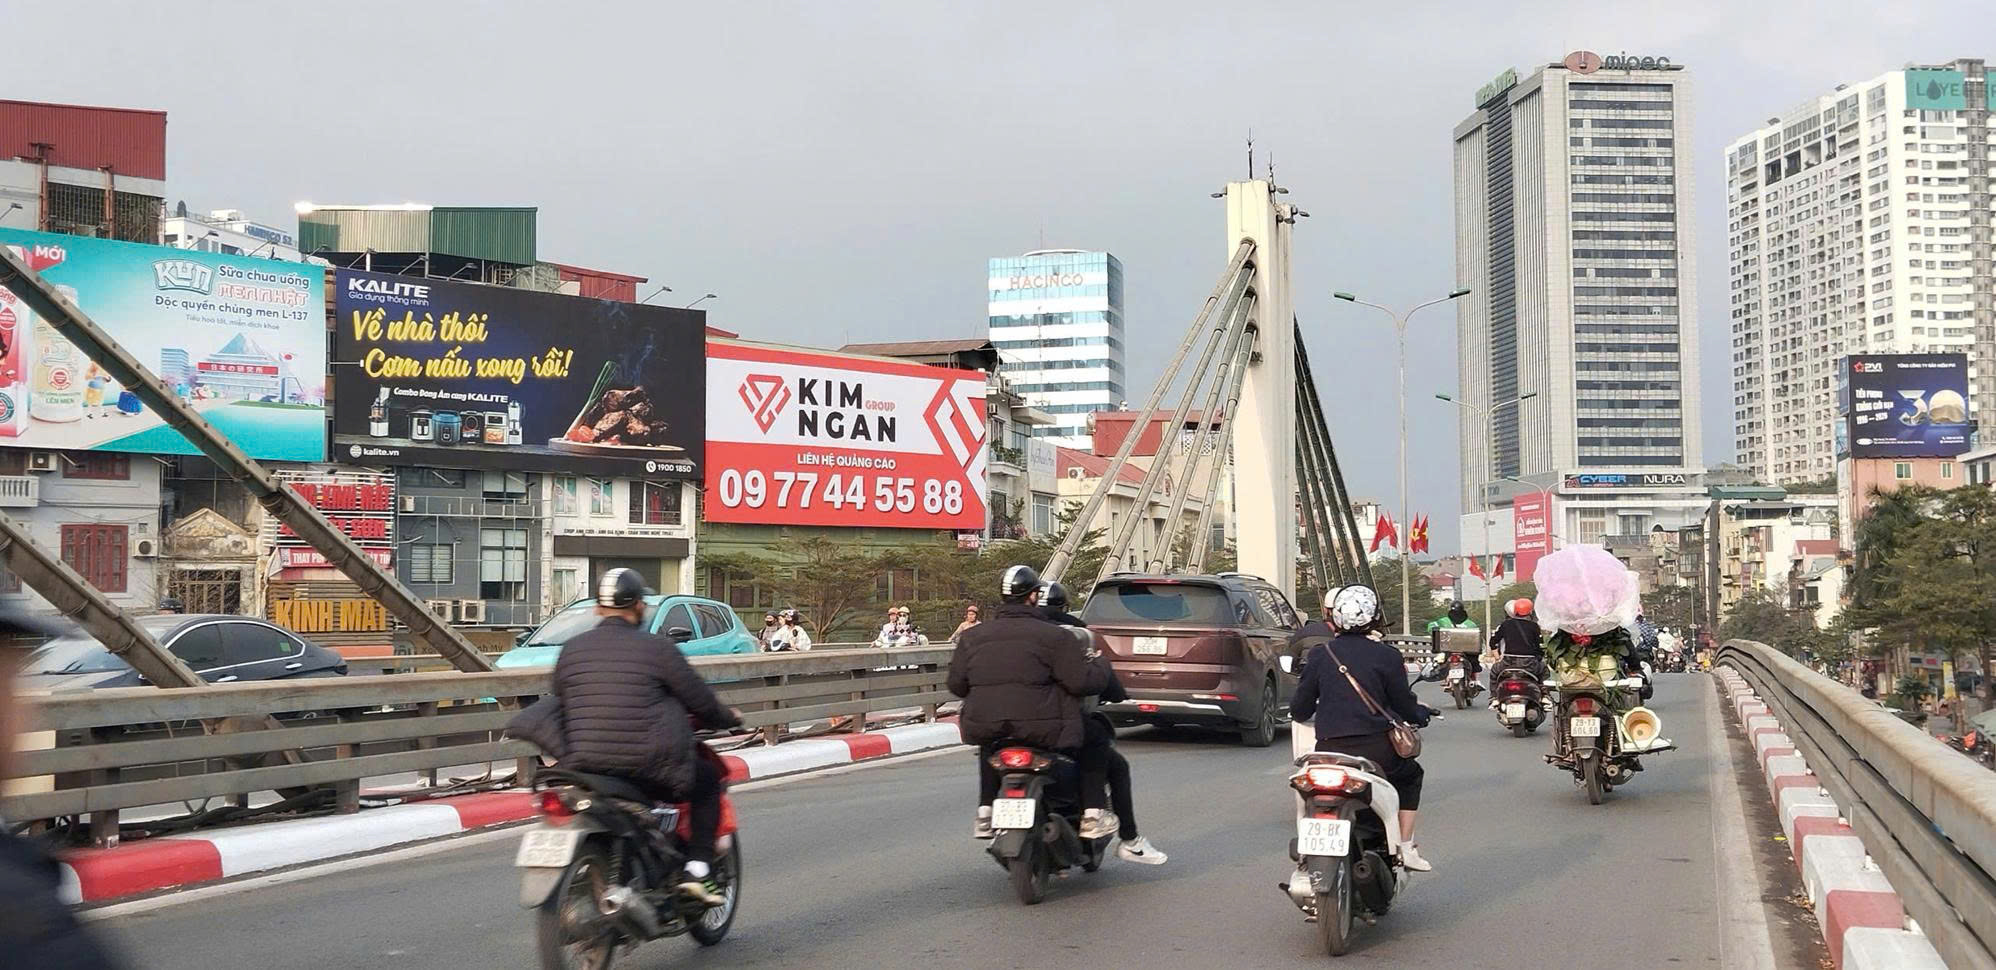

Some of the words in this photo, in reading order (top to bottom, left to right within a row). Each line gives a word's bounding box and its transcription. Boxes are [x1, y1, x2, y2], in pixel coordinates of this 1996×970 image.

[1604, 51, 1670, 72] mipec
[35, 244, 66, 262] MỚI
[219, 265, 243, 278] Sữa
[247, 269, 276, 283] chua
[280, 272, 309, 289] uống
[1010, 272, 1084, 290] HACINCO
[219, 283, 257, 301] MEN
[348, 278, 429, 298] KALITE
[155, 295, 177, 309] Độc
[181, 297, 216, 312] quyền
[218, 302, 253, 317] chủng
[256, 308, 279, 318] men
[282, 310, 308, 321] L-137
[348, 291, 363, 299] Gia
[364, 292, 386, 303] dụng
[386, 295, 410, 306] thông
[410, 298, 430, 307] minh
[352, 307, 386, 342] Về
[386, 310, 437, 342] nhà
[440, 311, 489, 342] thôi
[364, 347, 422, 378] Cơm
[425, 345, 473, 378] nấu
[476, 357, 526, 385] xong
[530, 346, 574, 378] rồi!
[393, 387, 419, 397] Combo
[468, 393, 508, 404] KALITE
[799, 377, 863, 410] KIM
[865, 399, 896, 412] GROUP
[799, 409, 897, 443] NGAN
[363, 447, 400, 457] kalite.vn
[797, 452, 820, 466] LIÊN
[821, 452, 835, 468] HỆ
[836, 453, 873, 470] QUẢNG
[873, 456, 897, 470] CÁO
[657, 462, 675, 471] 1900
[676, 463, 692, 473] 1850
[1580, 475, 1627, 483] CYBER
[1643, 474, 1685, 484] NURA
[719, 469, 767, 508] 09
[773, 471, 819, 509] 77
[823, 473, 867, 510] 44
[874, 476, 916, 513] 55
[923, 478, 963, 515] 88
[293, 552, 311, 563] THAY
[1307, 822, 1341, 836] 29-BK
[1304, 838, 1345, 853] 105.49
